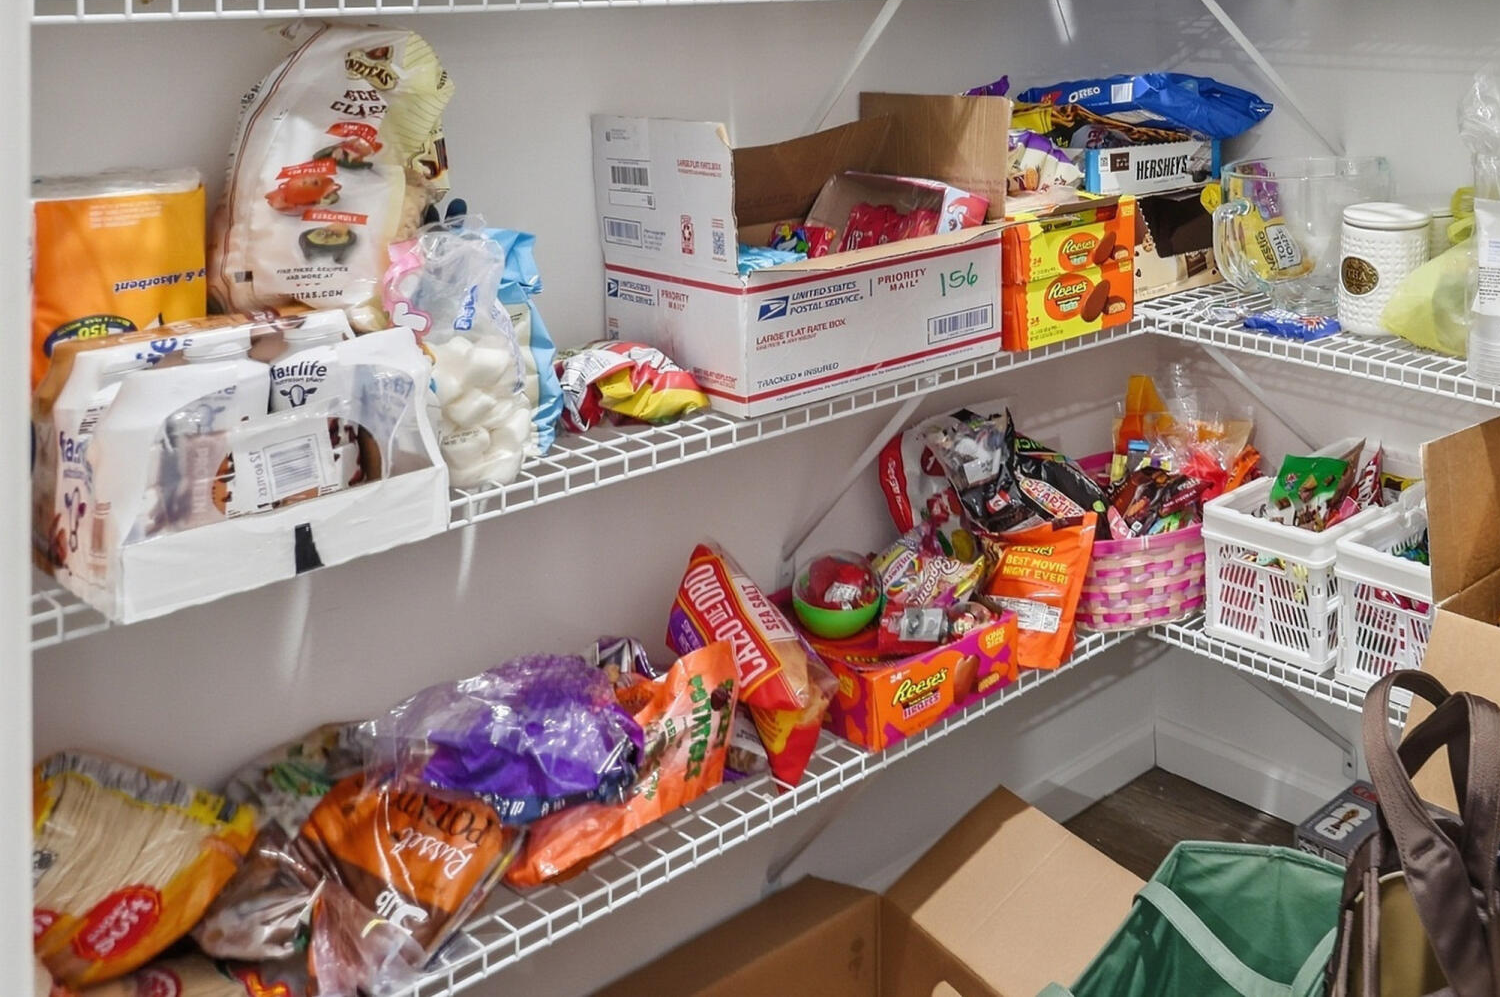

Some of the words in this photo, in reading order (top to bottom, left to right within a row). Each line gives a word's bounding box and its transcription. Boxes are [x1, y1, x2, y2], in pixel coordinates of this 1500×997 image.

[1068, 86, 1101, 103] OREO
[1136, 154, 1188, 181] HERSHEY'S
[1061, 240, 1096, 254] Reese's
[114, 272, 183, 293] Absorbent
[878, 268, 927, 286] PRIORITY
[889, 280, 915, 293] MAIL
[939, 261, 979, 298] 156
[291, 289, 344, 301] ITAS.COM
[661, 289, 690, 303] PRIORITY
[791, 287, 826, 301] UNITED
[826, 281, 857, 295] STATES
[1048, 280, 1088, 300] Reese's
[790, 299, 822, 316] POSTAL
[822, 294, 860, 311] SERVICE
[756, 331, 785, 346] LARGE
[786, 326, 806, 338] FLAT
[806, 322, 828, 335] RATE
[828, 318, 847, 330] BOX
[270, 360, 327, 381] fairlife
[757, 373, 797, 390] TRACKED
[803, 362, 839, 377] INSURED
[1005, 554, 1029, 566] BEST
[1030, 559, 1068, 573] MOVIE
[1002, 565, 1032, 578] NIGHT
[1033, 571, 1068, 585] EVER!
[684, 564, 725, 612] ORO
[704, 602, 729, 628] DE
[741, 584, 765, 609] SALT
[758, 609, 781, 632] SEA
[715, 618, 768, 688] CAZO
[892, 668, 949, 707] Reese's
[389, 827, 479, 880] Russet
